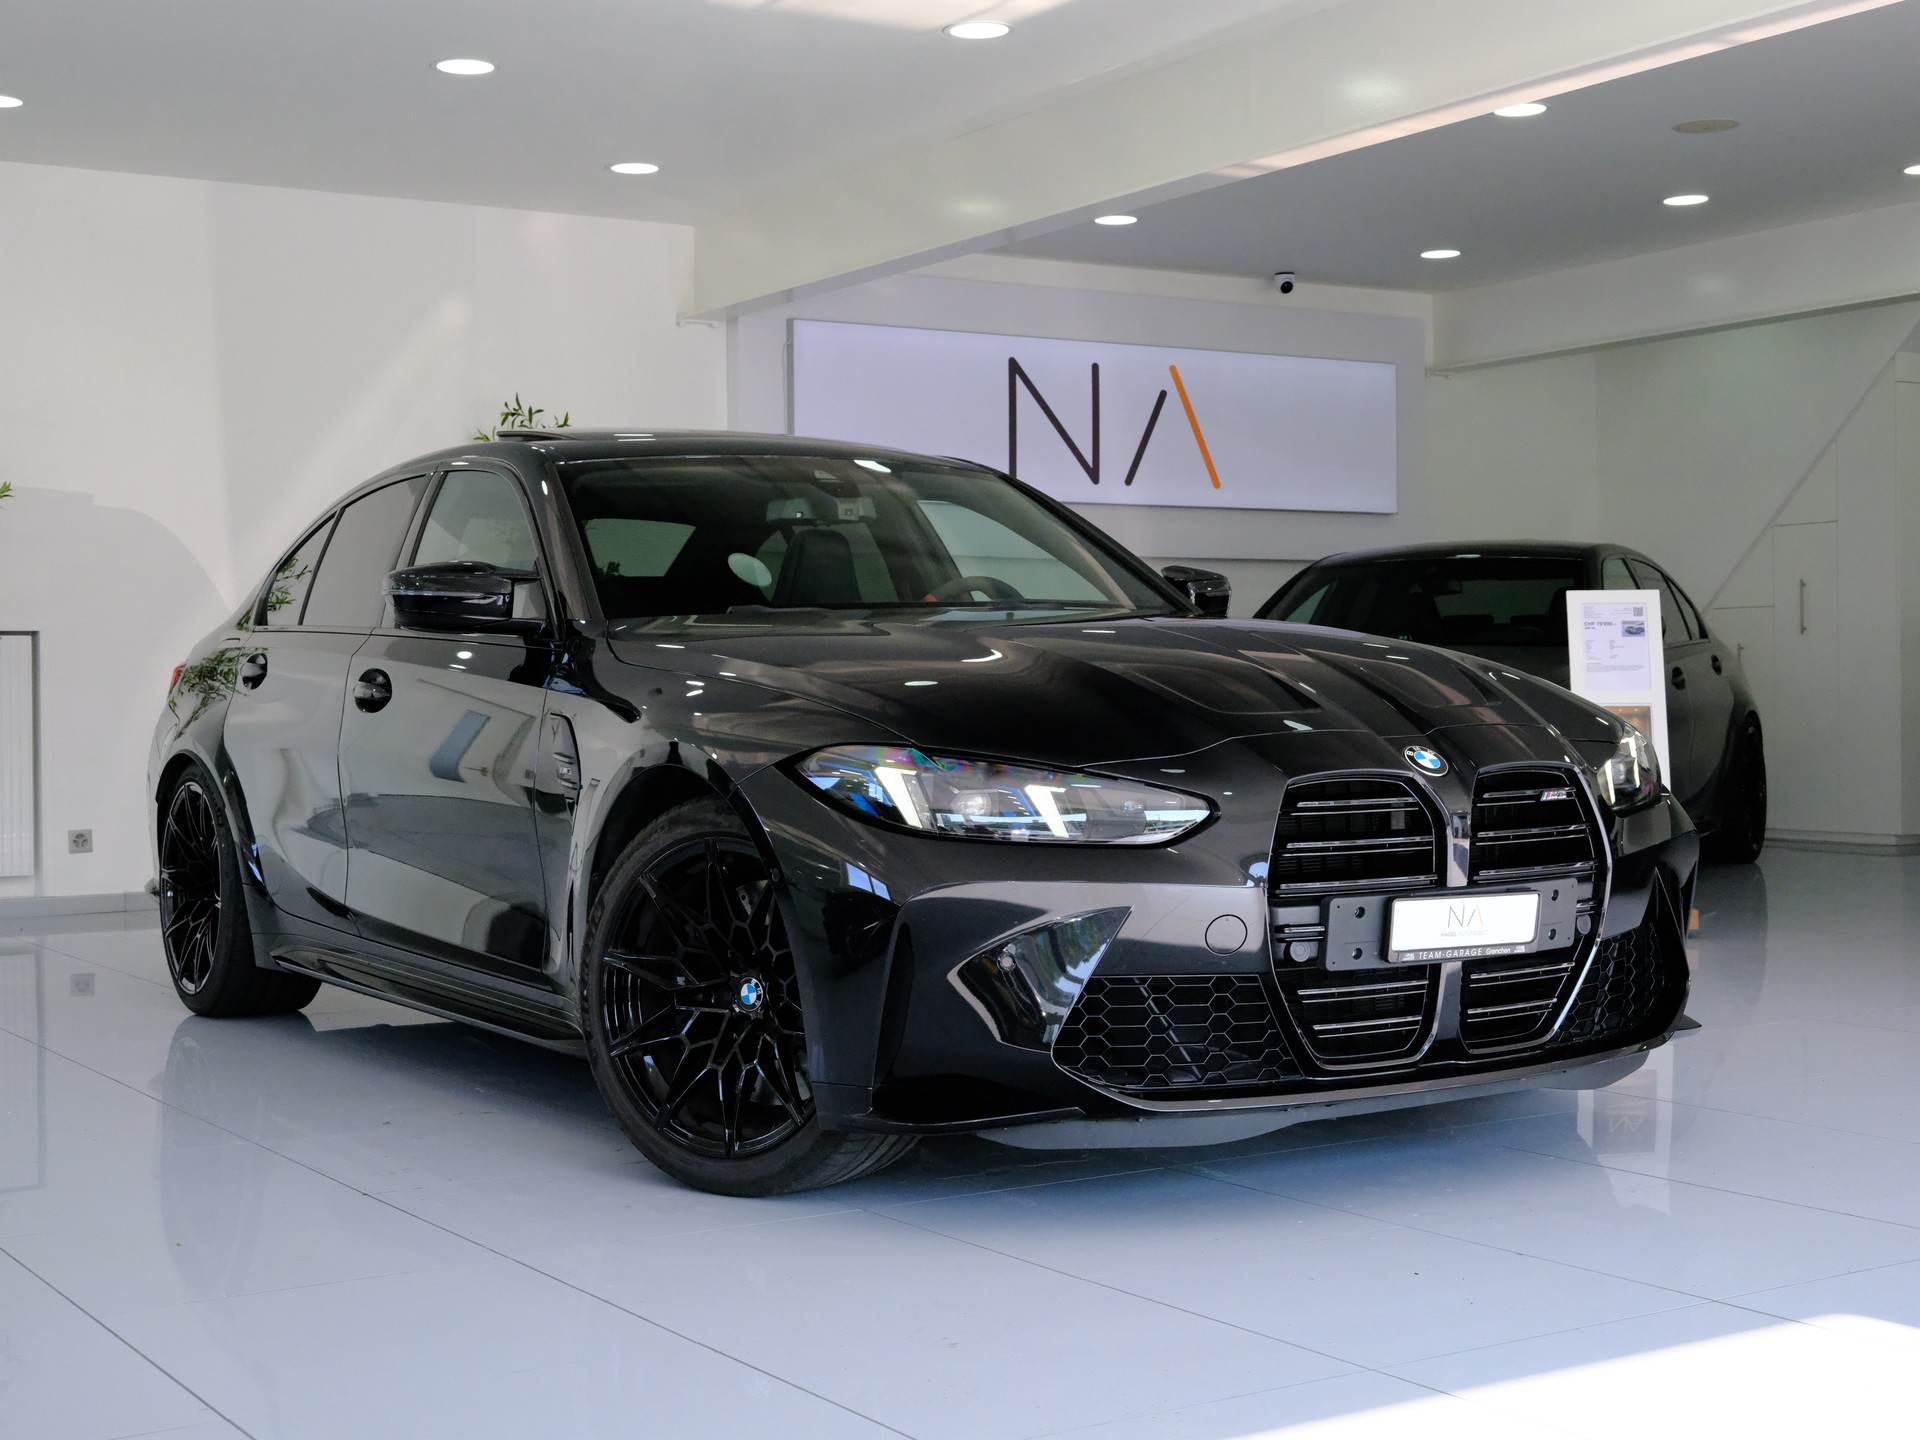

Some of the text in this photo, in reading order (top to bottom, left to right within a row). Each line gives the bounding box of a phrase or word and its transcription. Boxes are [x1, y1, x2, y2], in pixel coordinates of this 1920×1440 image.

[1008, 356, 1221, 490] NA
[1448, 904, 1483, 928] NA
[1418, 947, 1482, 960] TEAM-GARAGE
[1485, 947, 1511, 955] Grenchen
